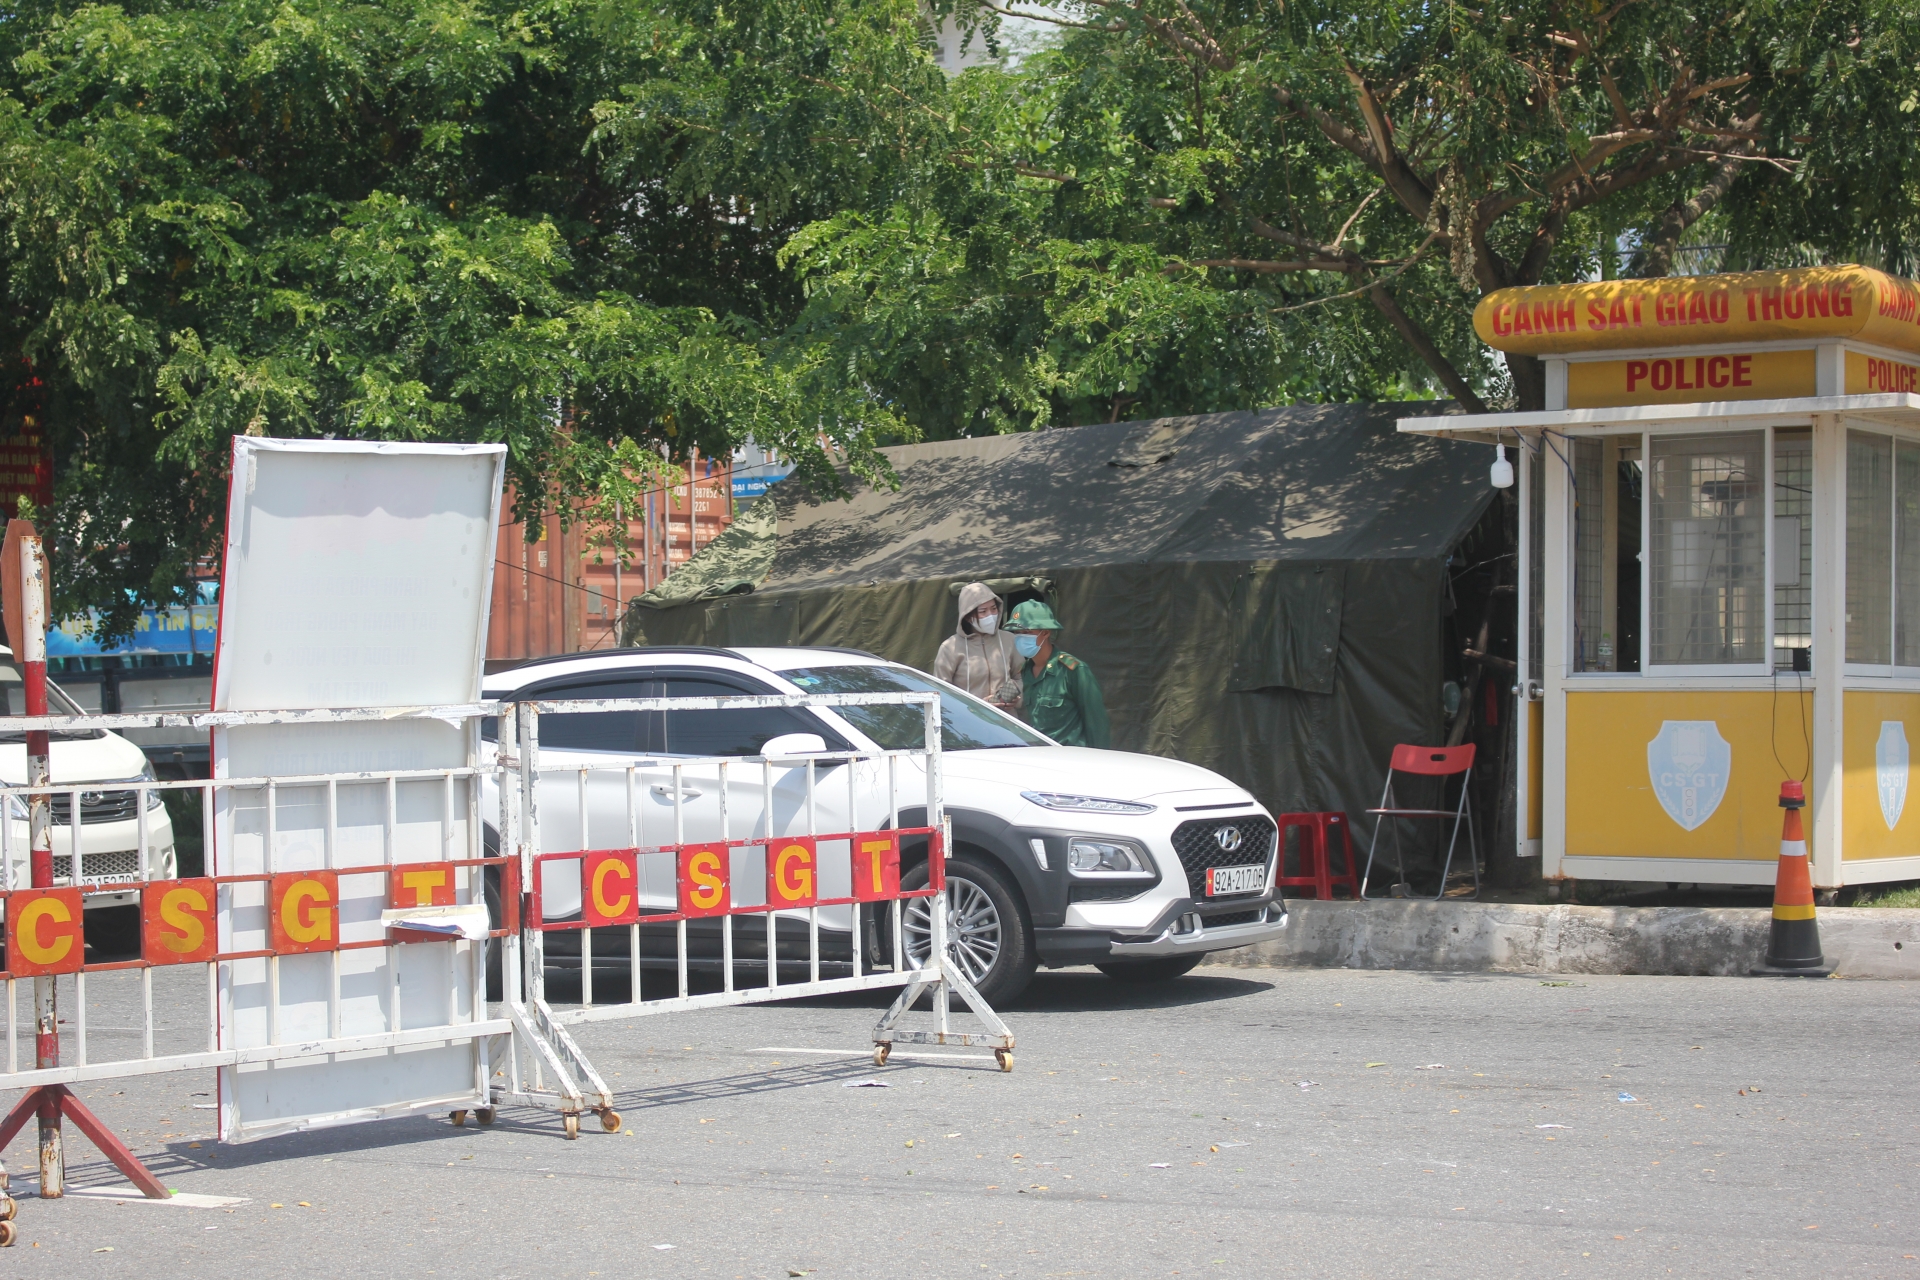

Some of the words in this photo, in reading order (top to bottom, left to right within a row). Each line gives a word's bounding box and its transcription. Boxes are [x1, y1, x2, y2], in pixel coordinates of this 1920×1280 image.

[1655, 289, 1730, 328] GIAO
[1627, 355, 1752, 392] POLICE
[1868, 358, 1917, 393] POLICE
[191, 609, 217, 634] CẬ
